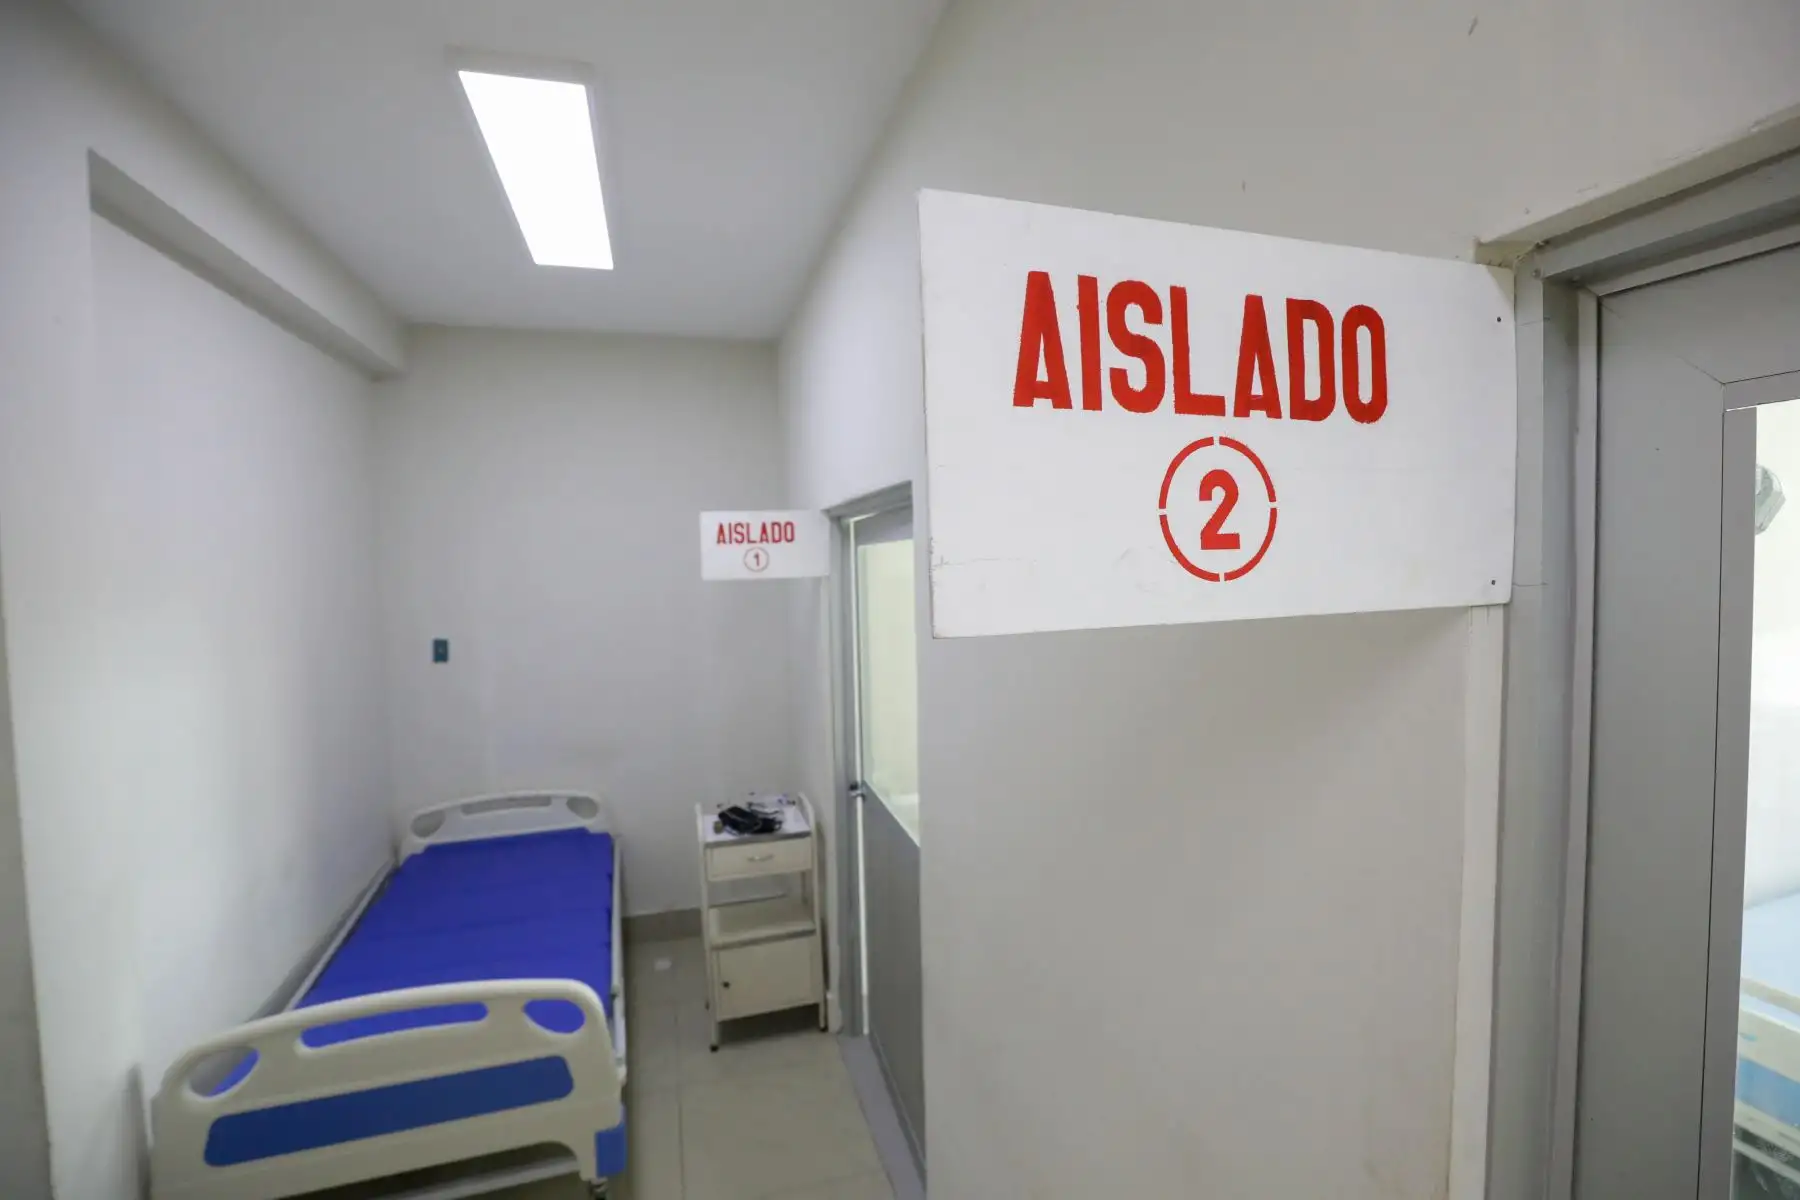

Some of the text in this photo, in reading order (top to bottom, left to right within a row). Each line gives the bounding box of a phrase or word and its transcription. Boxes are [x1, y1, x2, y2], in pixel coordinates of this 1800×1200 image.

[1013, 271, 1388, 424] AISLADO
[716, 521, 795, 545] AISLADO
[1199, 469, 1240, 551] 2
[753, 551, 761, 567] 1
